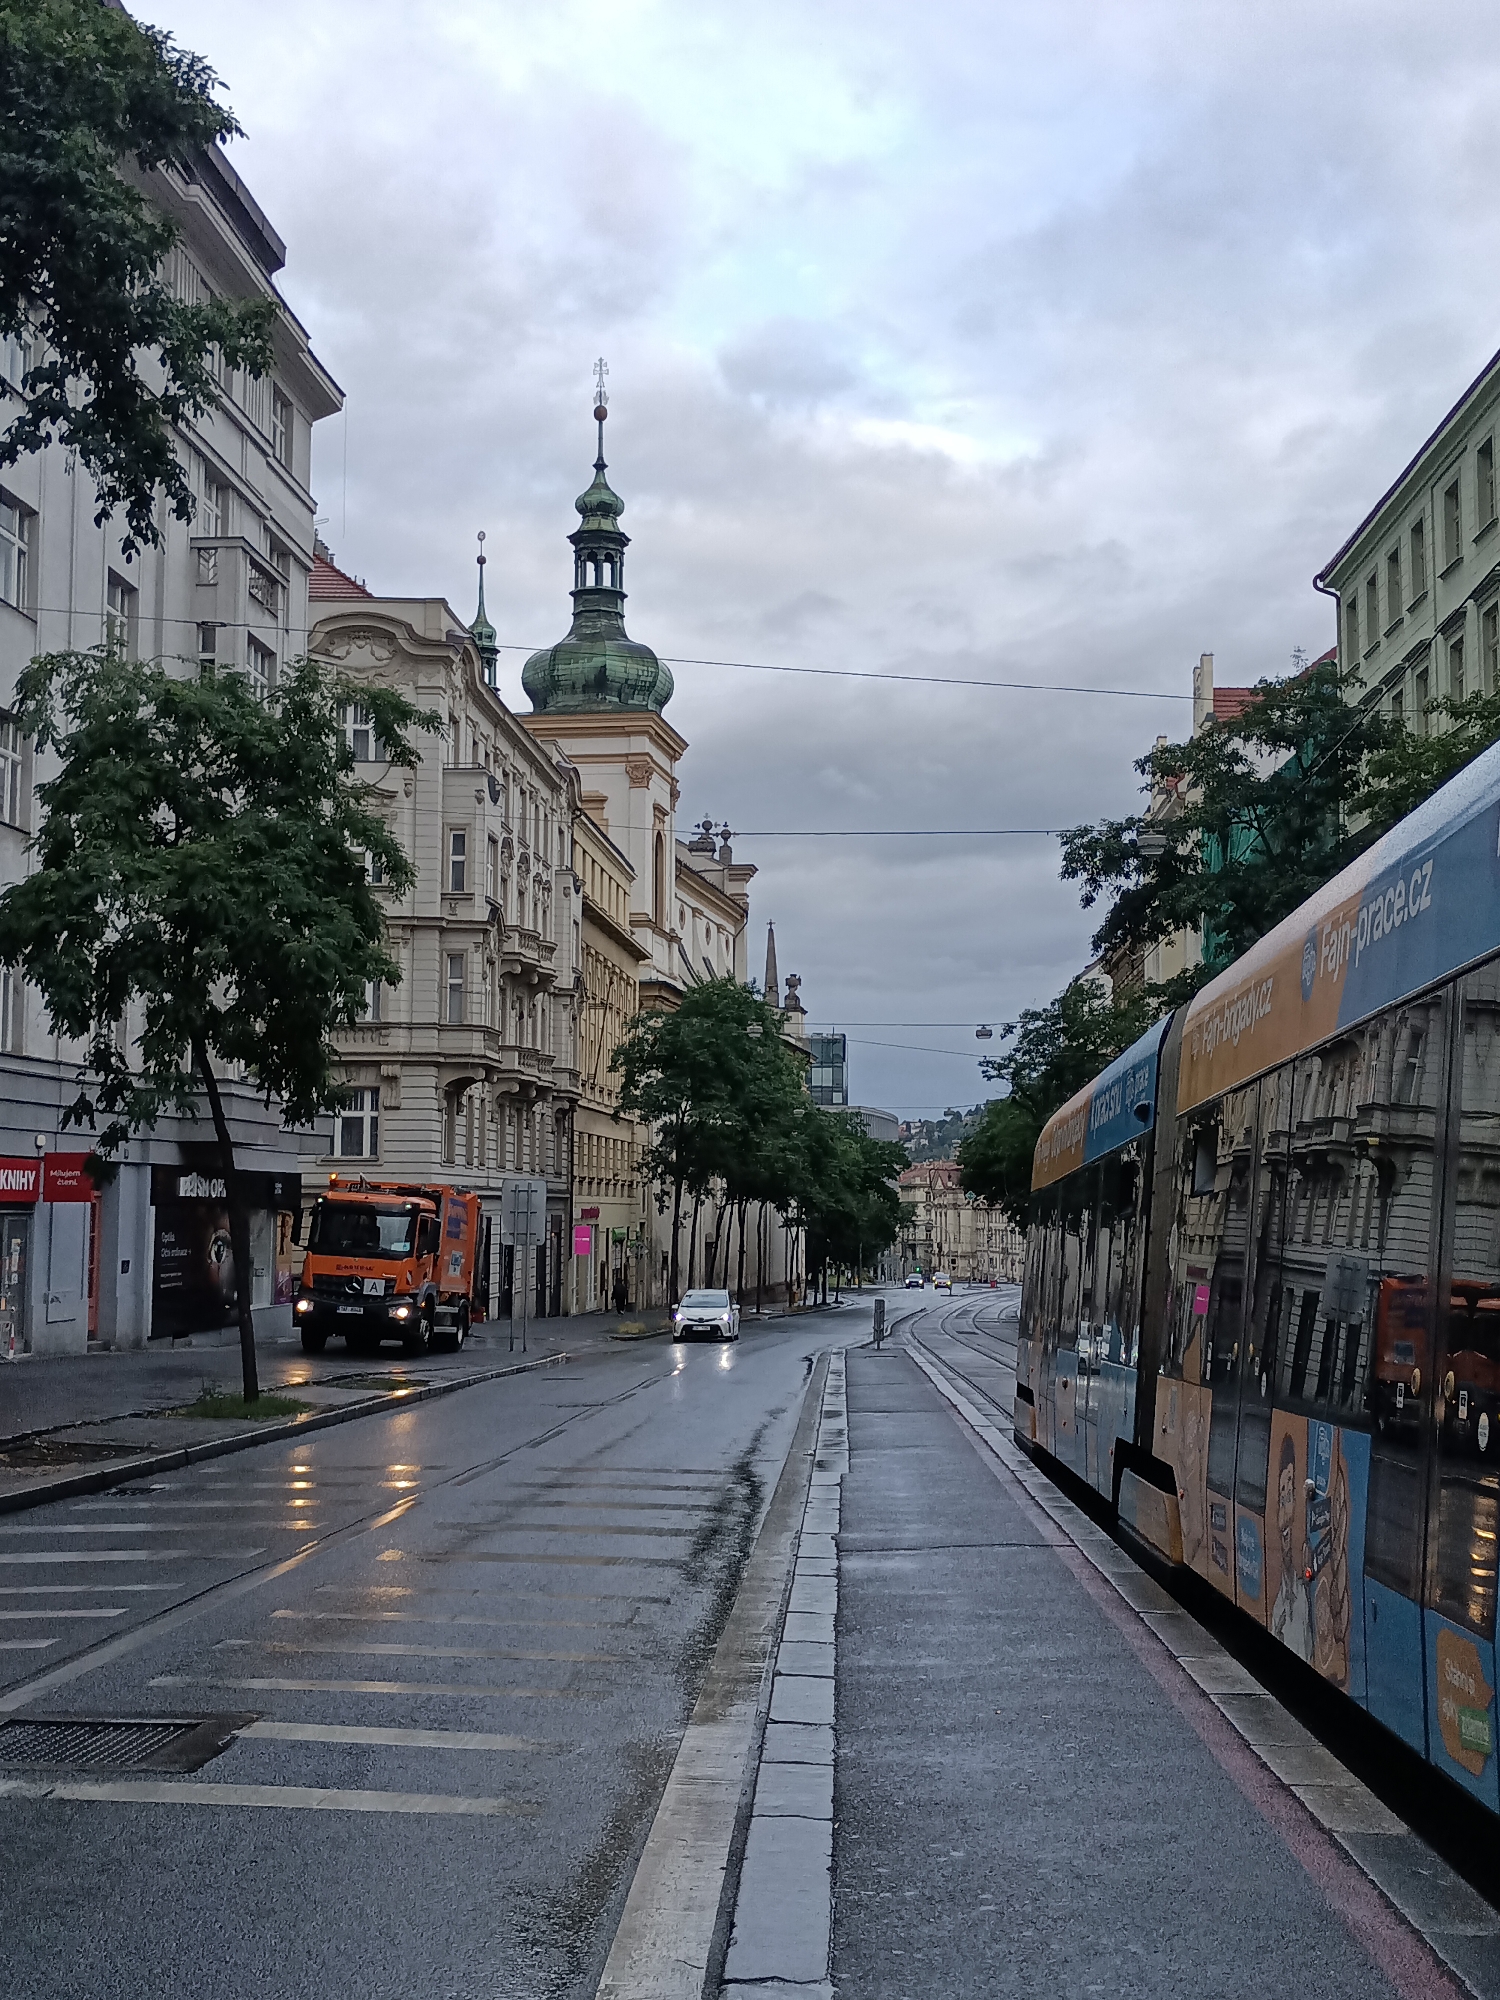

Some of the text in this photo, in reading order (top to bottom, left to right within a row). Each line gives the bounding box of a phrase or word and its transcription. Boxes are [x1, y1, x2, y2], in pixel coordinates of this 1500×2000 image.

[1320, 859, 1433, 983] Fajn-prace.cz
[1202, 978, 1273, 1060] Fajn-brigady.cz
[0, 1169, 36, 1191] KNIHY
[369, 1281, 378, 1293] A
